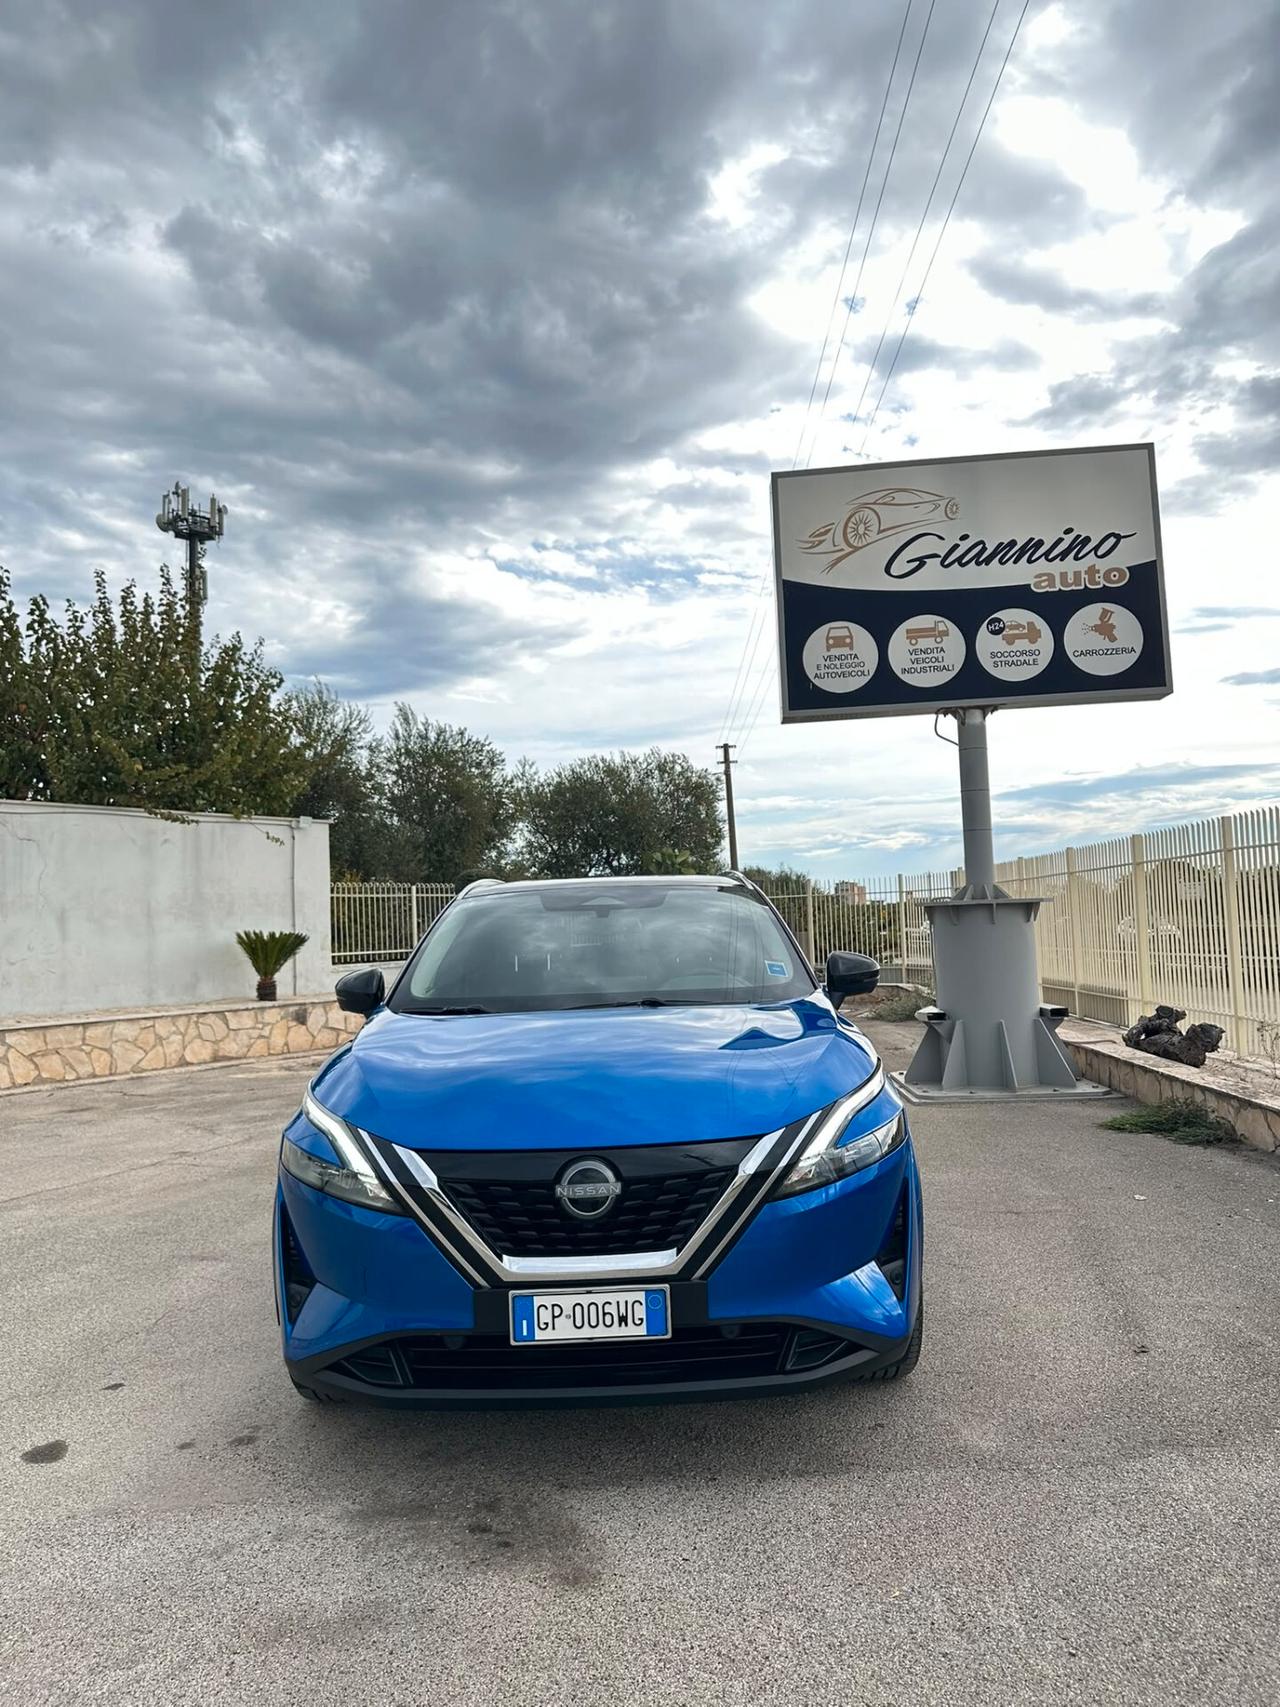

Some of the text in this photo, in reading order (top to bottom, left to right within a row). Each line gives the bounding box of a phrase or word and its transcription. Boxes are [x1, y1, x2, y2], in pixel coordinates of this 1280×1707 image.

[884, 527, 1138, 579] Giannino
[1033, 564, 1128, 591] auto
[988, 620, 1005, 632] H24
[908, 646, 946, 656] VENDITA
[990, 649, 1041, 659] SOCCORSO
[1072, 646, 1137, 658] CARROZZERIA
[822, 653, 860, 663] VENDITA
[910, 655, 945, 665] VEICOLI
[992, 658, 1039, 668] STRADALE
[816, 661, 866, 671] E NOLEGGIO
[900, 664, 955, 675] INDUSTRIALI
[813, 670, 871, 680] AUTOVEICOLI
[557, 1186, 620, 1196] NISSAN
